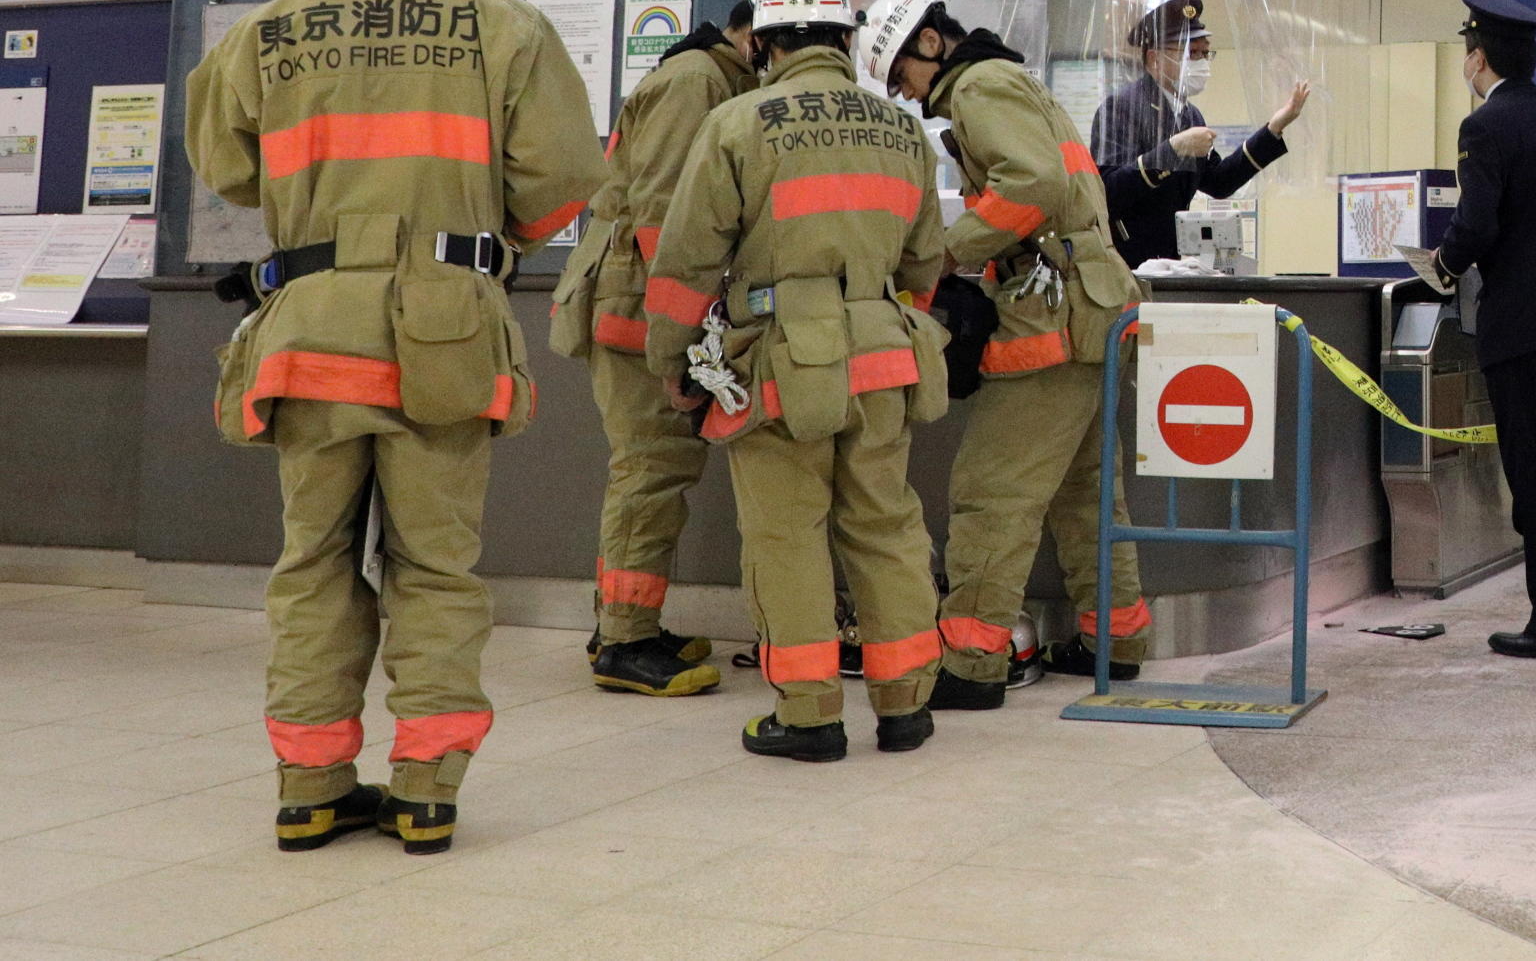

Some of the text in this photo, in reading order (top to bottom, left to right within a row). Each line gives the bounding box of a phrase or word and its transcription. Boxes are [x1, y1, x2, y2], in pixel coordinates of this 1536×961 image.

[262, 44, 482, 85] TOKYO FIRE DEPT
[757, 90, 915, 136] 東京消防庁
[766, 128, 835, 156] TOKYO
[838, 128, 881, 147] FIRE
